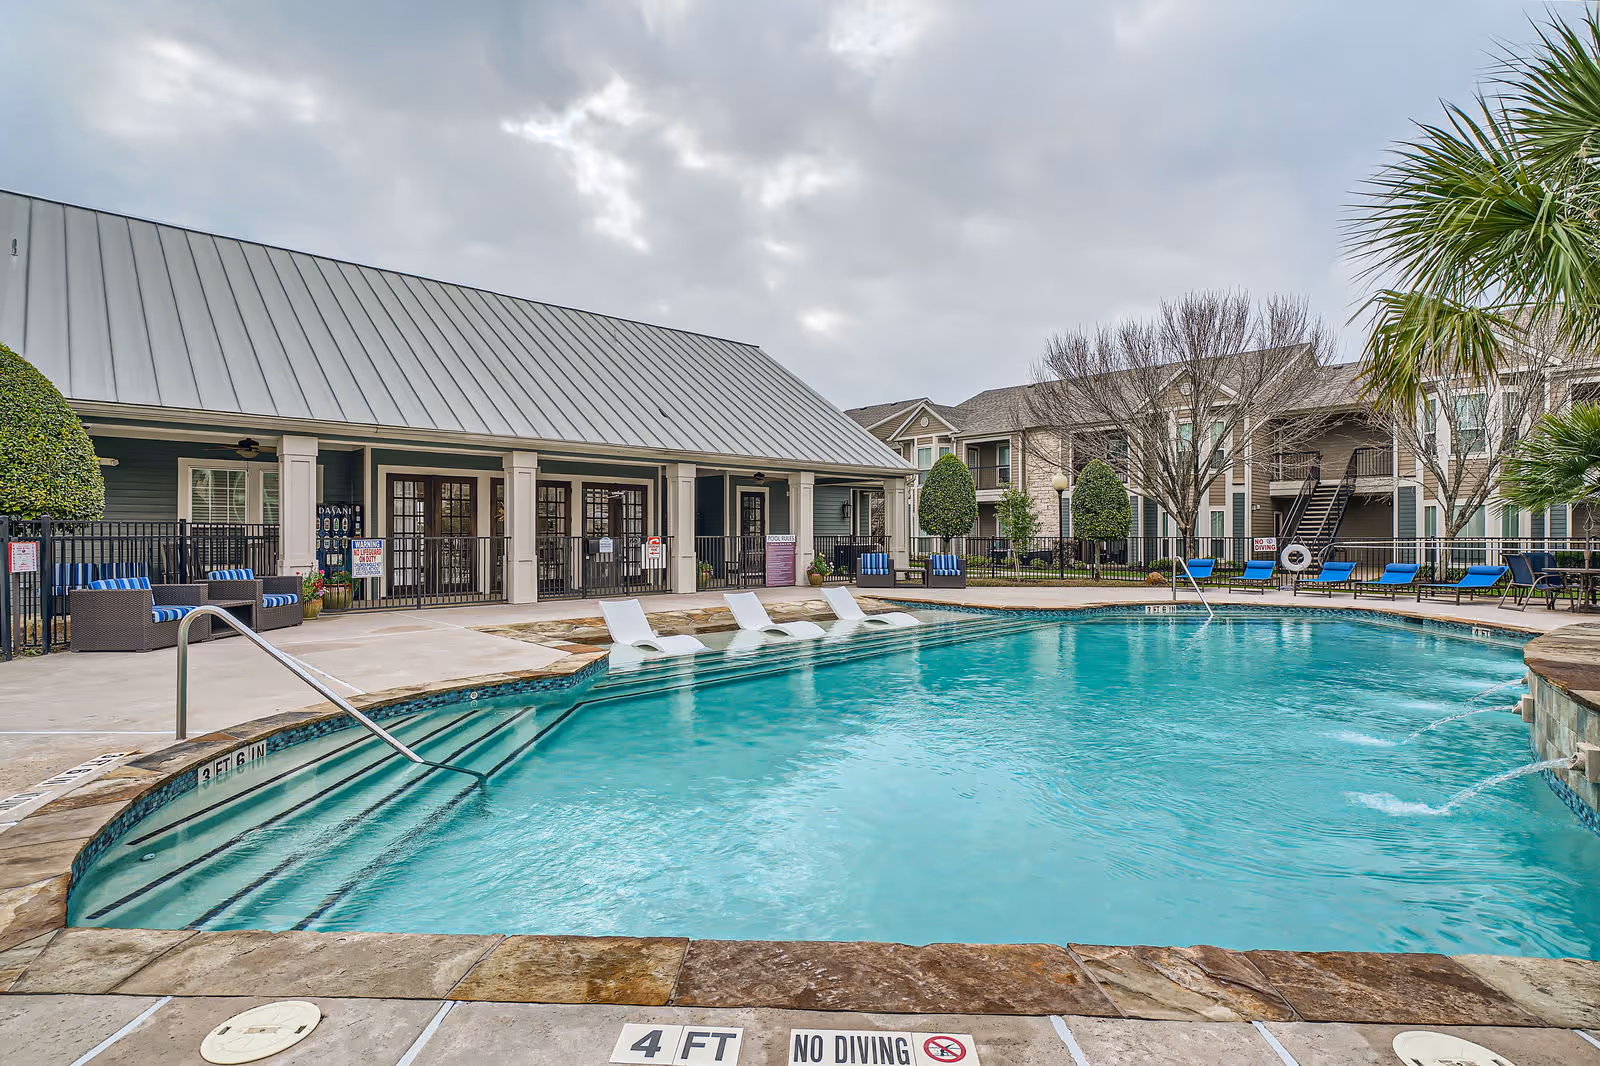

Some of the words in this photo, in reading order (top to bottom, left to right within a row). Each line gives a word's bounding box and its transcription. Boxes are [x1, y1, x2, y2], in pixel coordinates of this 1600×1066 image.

[318, 506, 352, 516] DASANI
[355, 540, 380, 548] WARNING
[1482, 630, 1490, 638] FT
[202, 768, 210, 782] 3
[216, 757, 230, 776] FT
[236, 752, 245, 766] 6
[252, 744, 264, 760] IN
[630, 1030, 663, 1058] 4
[681, 1032, 736, 1062] FT
[794, 1034, 824, 1062] NO
[834, 1036, 910, 1066] DIVING
